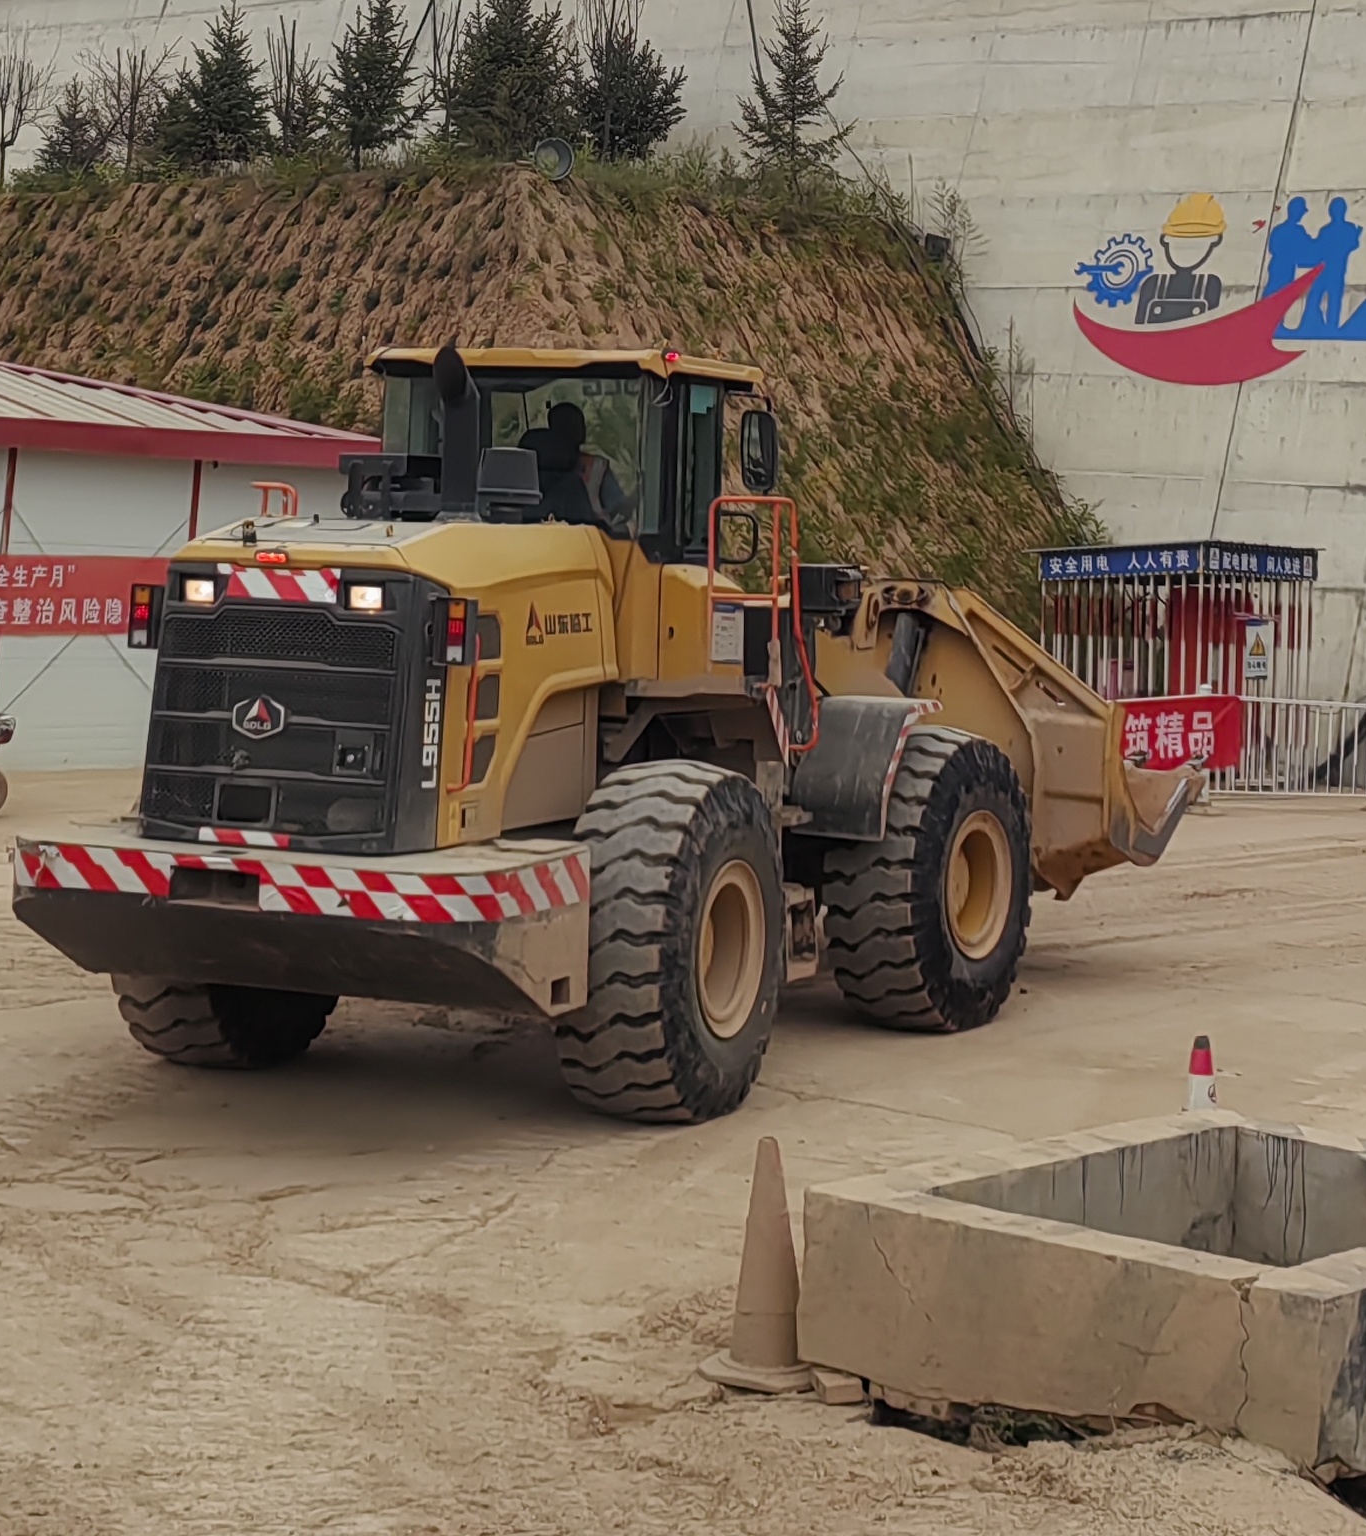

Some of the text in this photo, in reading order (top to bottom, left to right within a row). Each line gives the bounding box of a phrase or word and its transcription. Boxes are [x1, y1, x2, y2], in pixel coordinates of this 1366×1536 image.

[1049, 549, 1190, 575] 安全用电 人人有责
[544, 612, 593, 635] 山东临工
[421, 678, 442, 789] L955H
[1124, 711, 1215, 760] 筑精品
